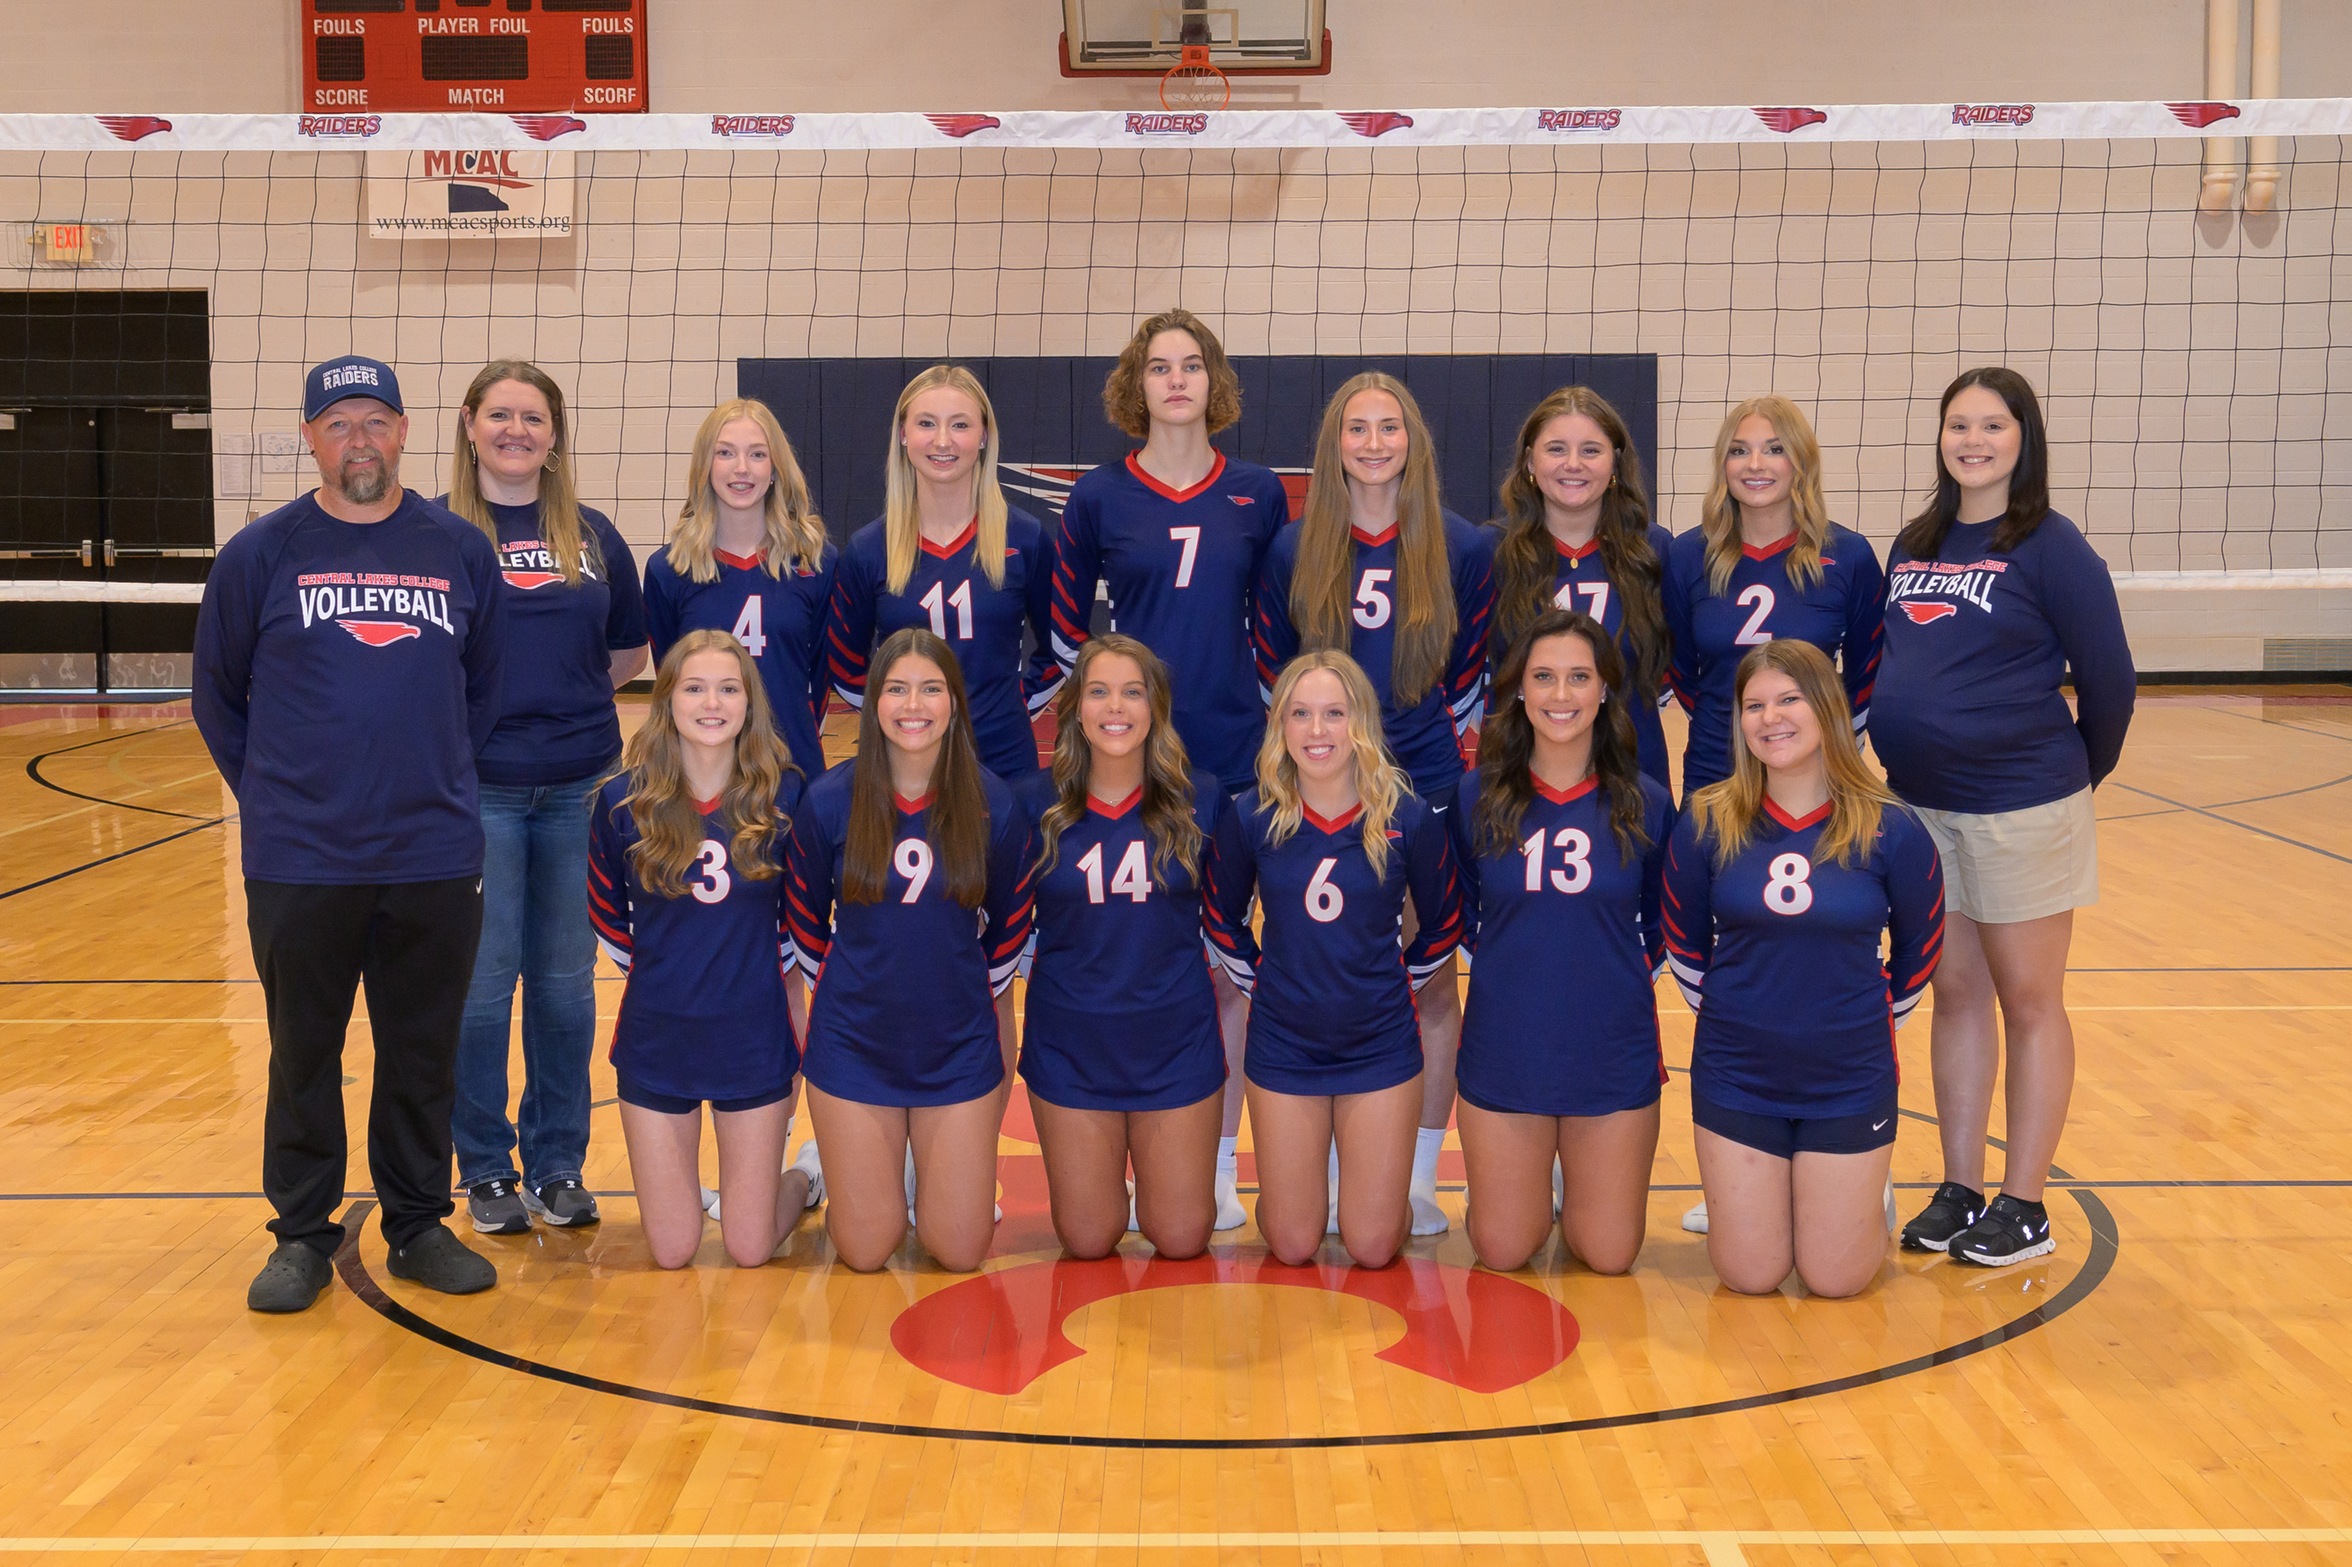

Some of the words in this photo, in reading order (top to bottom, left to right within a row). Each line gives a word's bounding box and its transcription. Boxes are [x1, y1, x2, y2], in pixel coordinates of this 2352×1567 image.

[313, 19, 365, 35] FOULS
[418, 18, 479, 34] PLAYER
[489, 18, 531, 34] FOUL
[582, 18, 634, 34] FOULS
[315, 89, 369, 105] SCORE
[448, 88, 504, 105] MATCH
[712, 114, 796, 137] RAIDERS
[1125, 113, 1209, 135] RAIDERS
[1537, 109, 1622, 132] RAIDERS
[1952, 103, 2036, 126] RAIDERS
[298, 115, 382, 138] RAIDERS
[423, 150, 519, 177] MCAC
[375, 214, 572, 233] www.mcacsports.org
[55, 225, 85, 249] EXIT
[323, 370, 379, 391] RAIDERS
[501, 540, 540, 553] LAKES
[1169, 526, 1201, 589] 7
[1930, 561, 1966, 575] LAKES
[298, 572, 356, 586] CENTRAL
[357, 572, 398, 585] LAKES
[400, 575, 450, 592] COLLEGE
[1885, 571, 1997, 614] VOLLEYBALL
[918, 578, 974, 640] 11
[1352, 568, 1393, 630] 5
[299, 586, 454, 636] VOLLEYBALL
[1734, 583, 1776, 645] 2
[731, 594, 767, 657] 4
[691, 838, 732, 904] 3
[893, 837, 935, 904] 9
[1518, 827, 1593, 894] 13
[1076, 840, 1153, 905] 14
[1763, 852, 1814, 916] 8
[1304, 857, 1345, 923] 6
